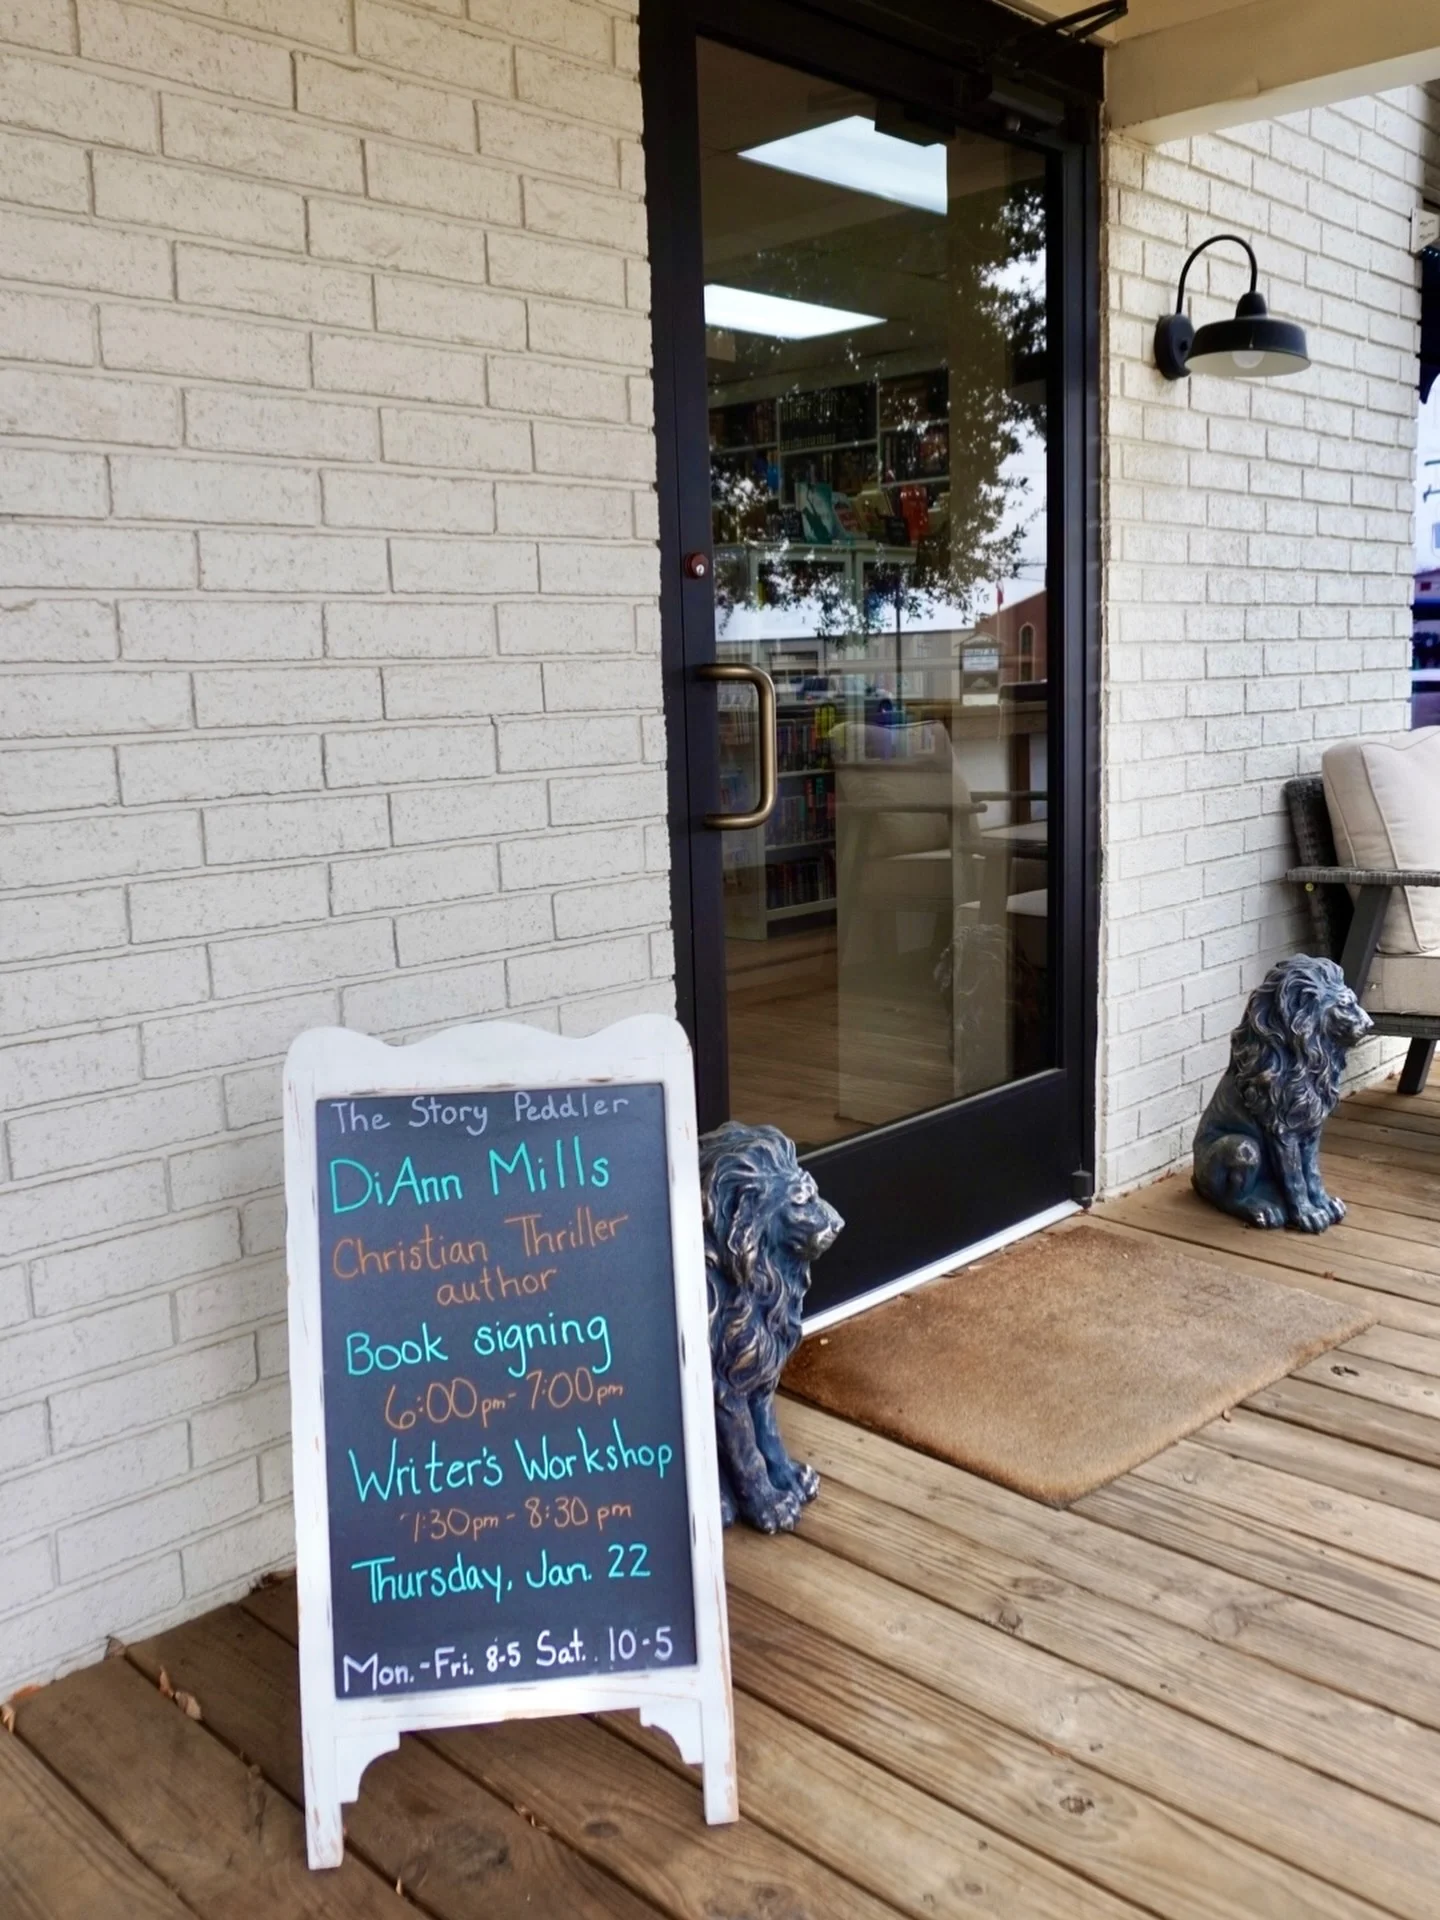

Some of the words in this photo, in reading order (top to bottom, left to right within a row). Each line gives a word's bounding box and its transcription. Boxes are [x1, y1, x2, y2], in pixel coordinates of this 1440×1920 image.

[331, 1101, 391, 1134] The
[408, 1096, 488, 1136] Story
[513, 1091, 629, 1123] Peddler
[330, 1156, 463, 1214] DiAnn
[489, 1136, 610, 1195] Mills
[333, 1224, 488, 1278] Christian
[505, 1207, 629, 1258] Thriller
[437, 1264, 557, 1306] author
[346, 1322, 448, 1375] Book
[474, 1312, 612, 1377] signing
[348, 1437, 503, 1502] Writer's
[515, 1418, 673, 1478] Workshop
[351, 1552, 513, 1603] Thursday,
[526, 1550, 592, 1588] Jan.
[608, 1543, 651, 1578] 22
